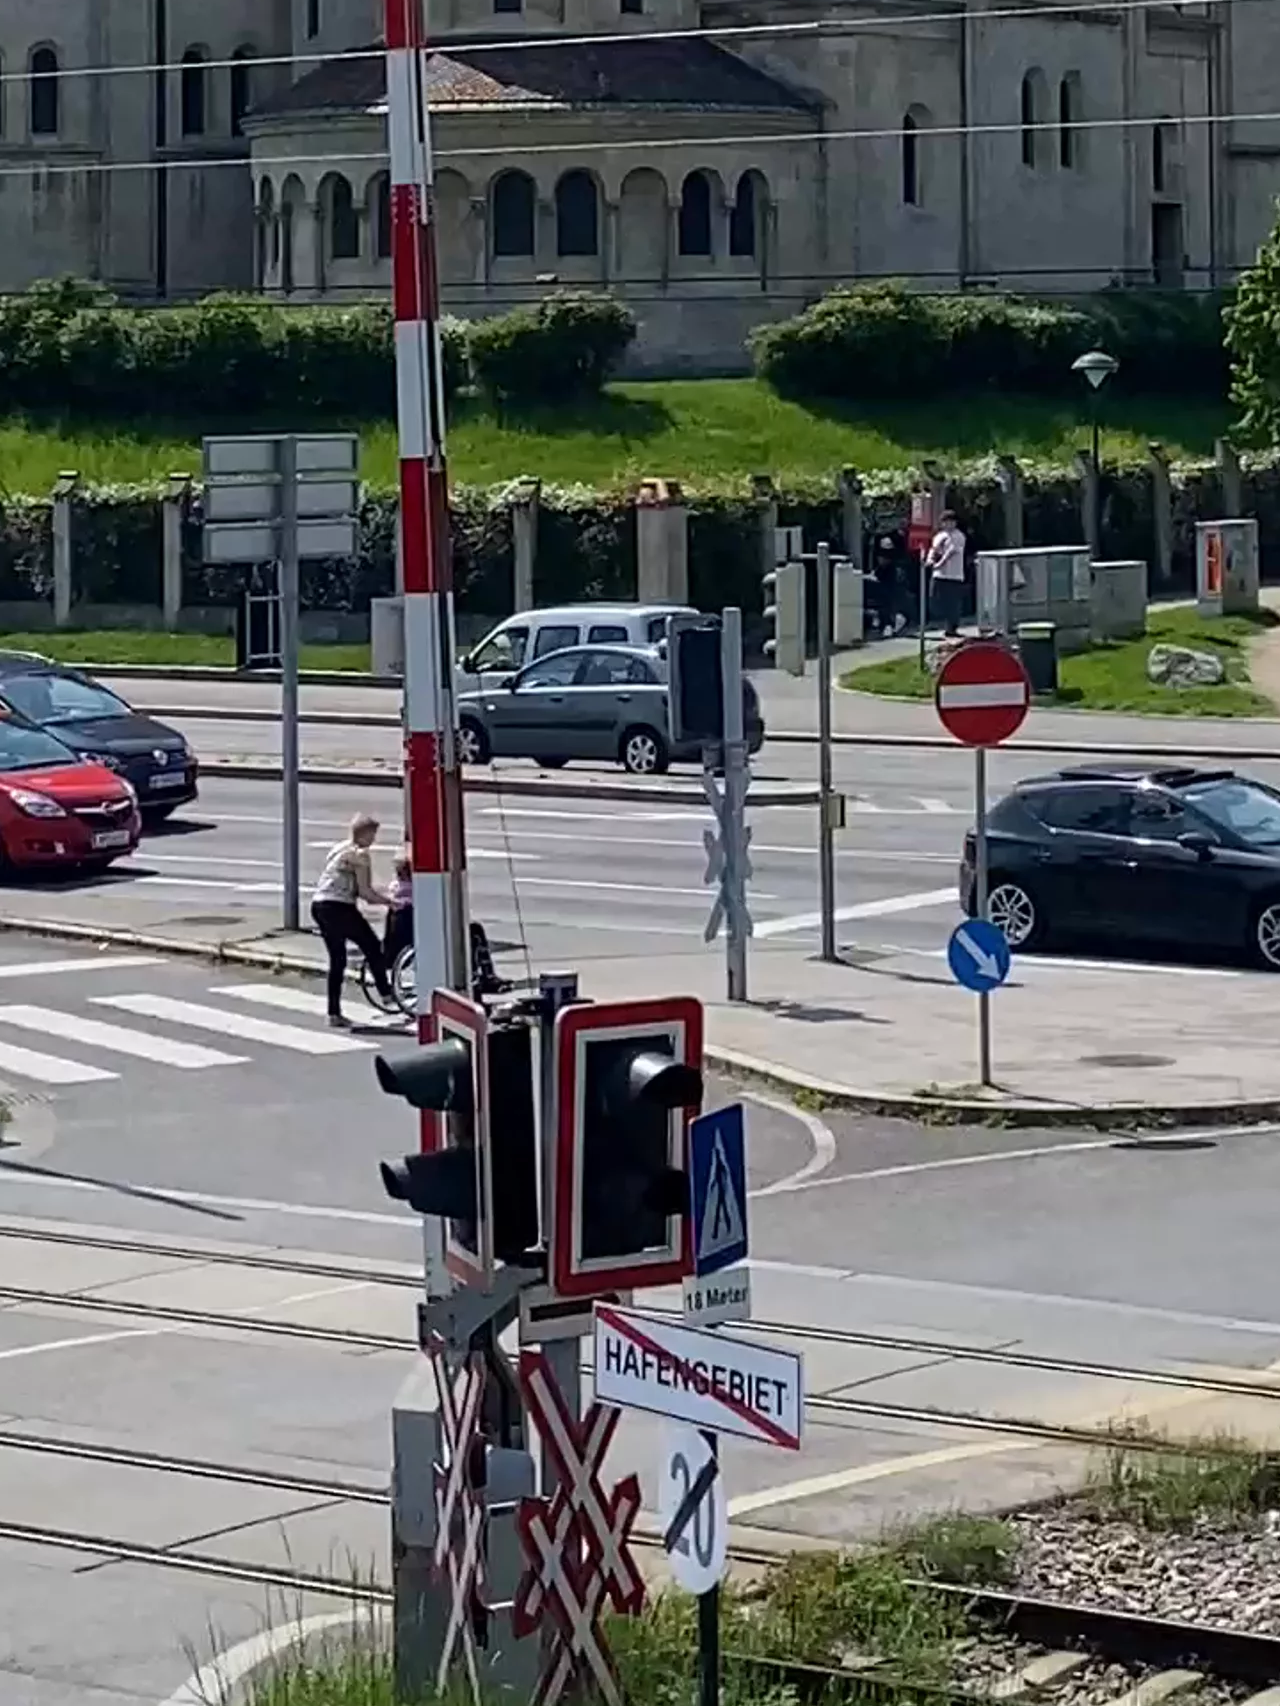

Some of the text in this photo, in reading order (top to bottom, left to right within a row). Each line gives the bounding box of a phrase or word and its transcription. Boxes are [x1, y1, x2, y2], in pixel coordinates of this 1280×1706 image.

[706, 1287, 748, 1309] Meter
[605, 1336, 788, 1417] HAFENGEBIET
[670, 1451, 716, 1568] 20
